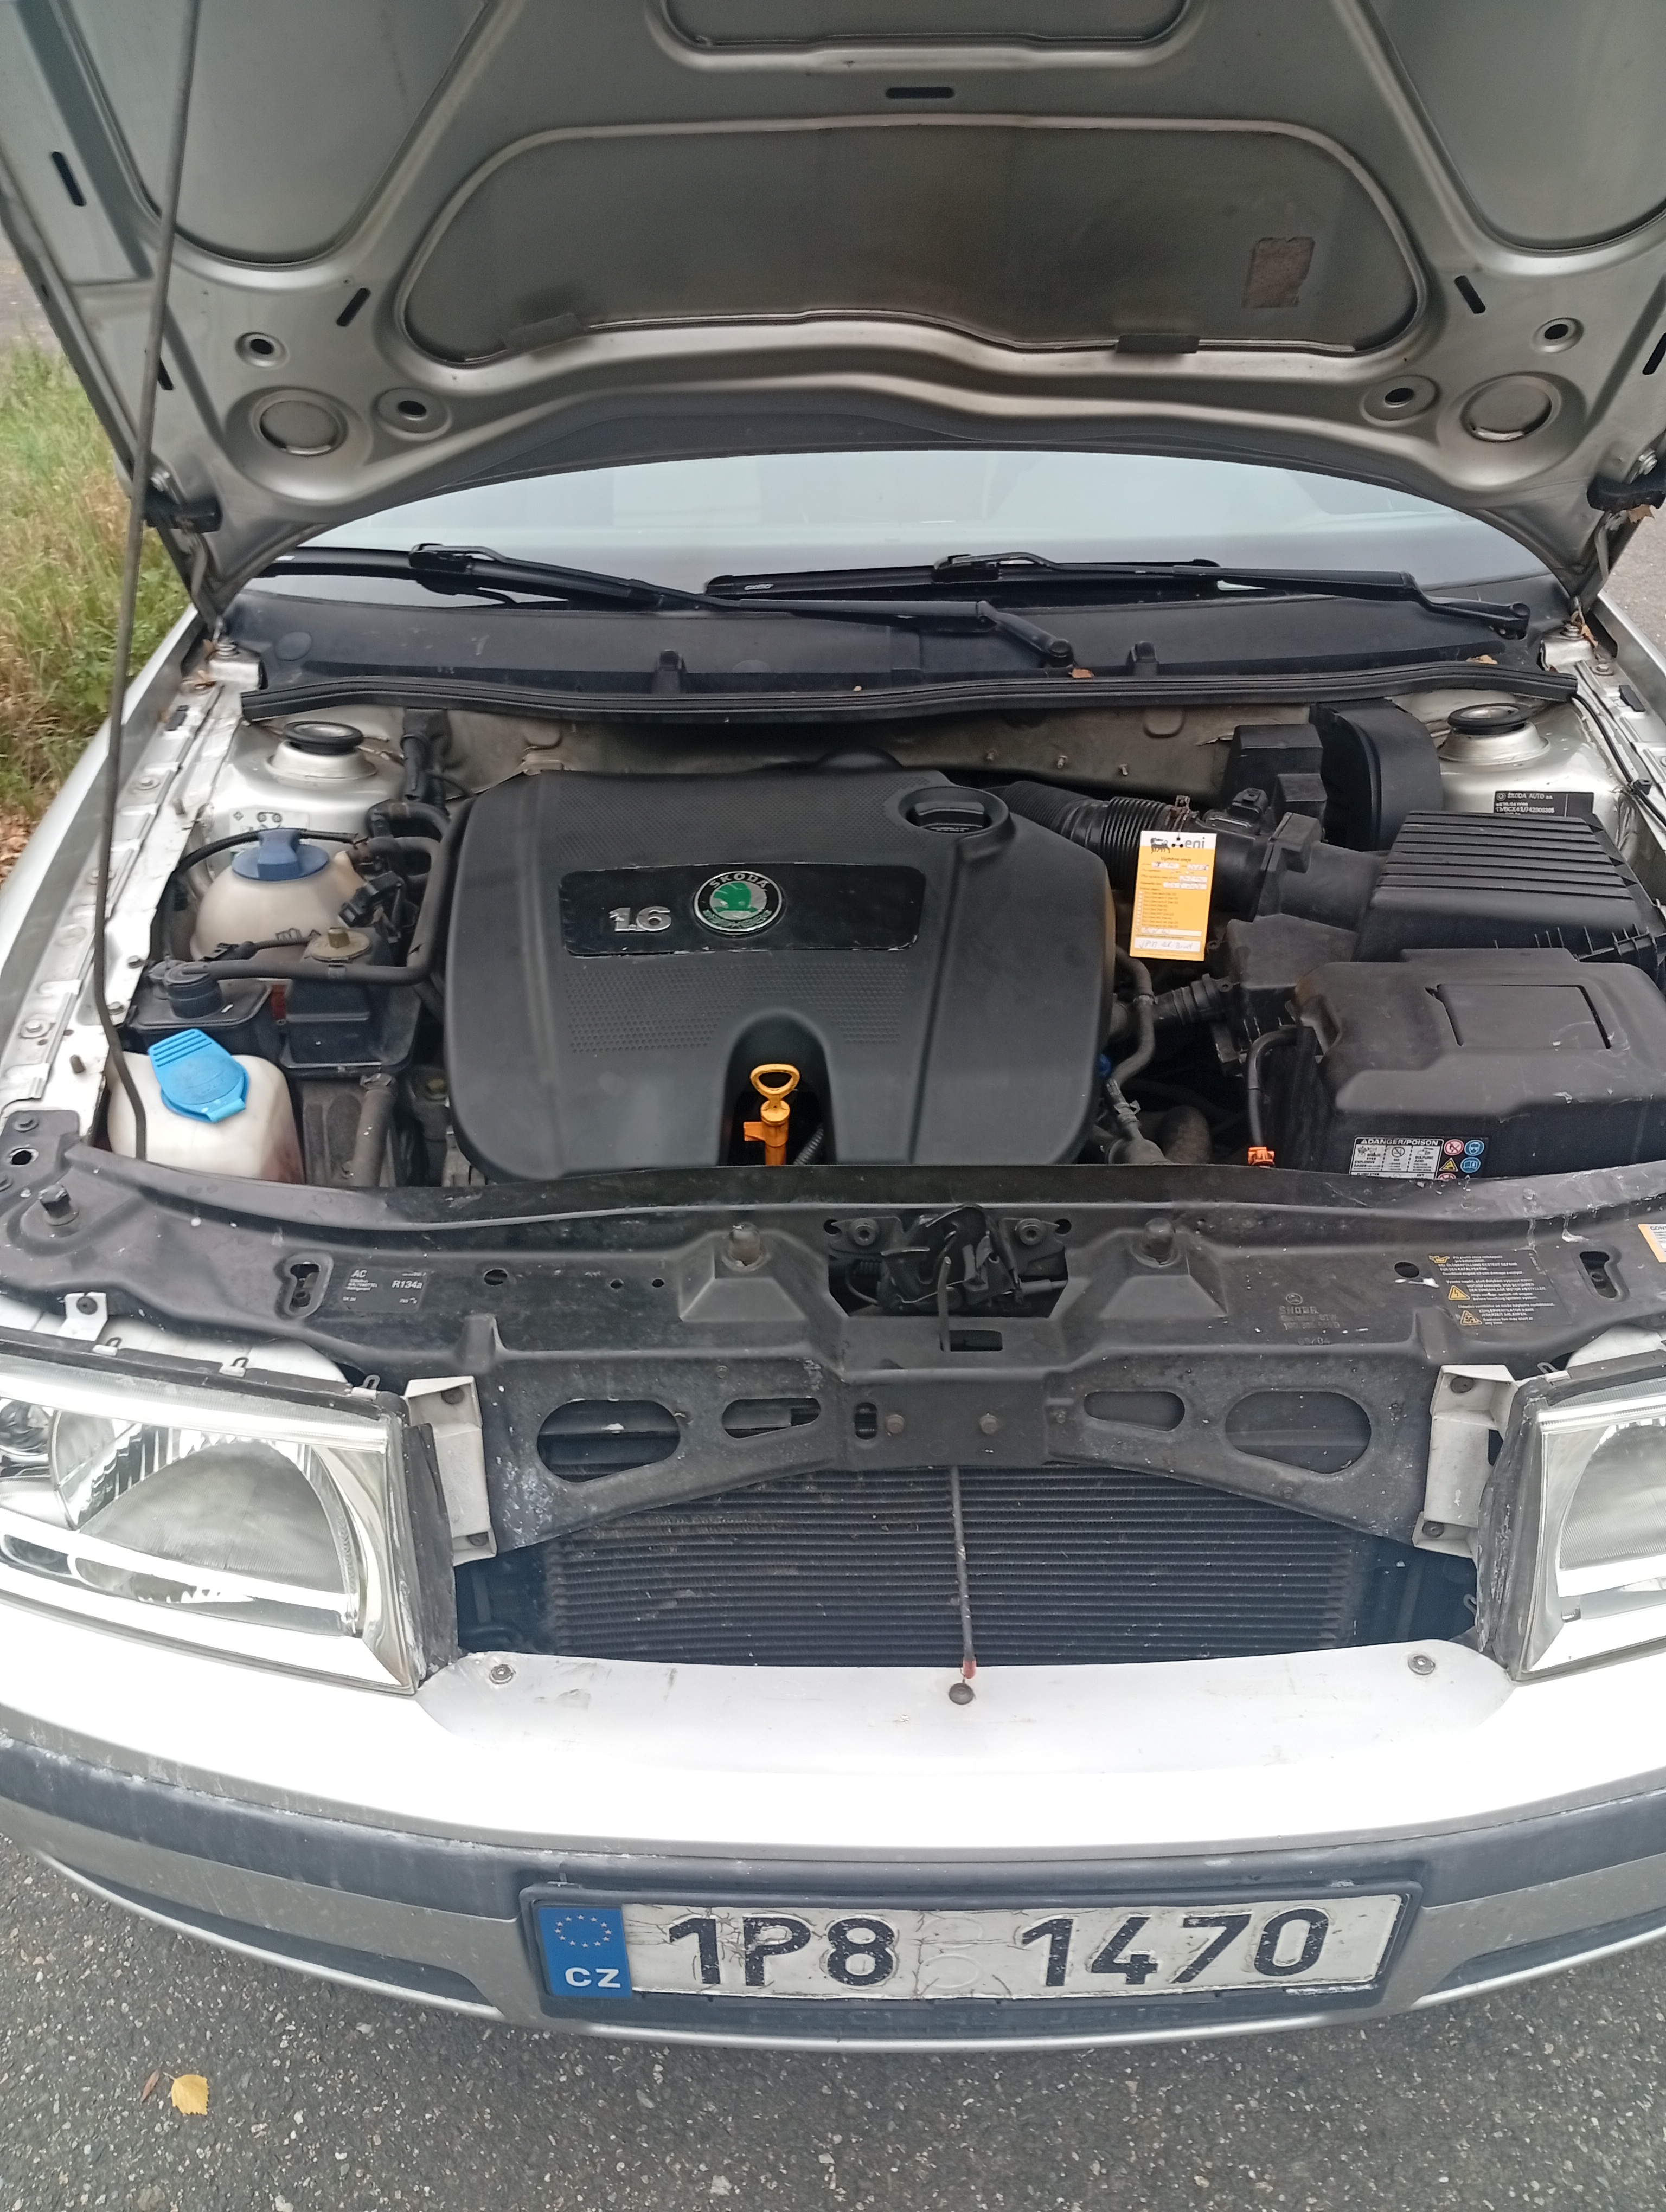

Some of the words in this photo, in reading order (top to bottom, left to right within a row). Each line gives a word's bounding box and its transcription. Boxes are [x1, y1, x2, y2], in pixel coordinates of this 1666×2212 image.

[1185, 837, 1205, 849] eni
[609, 906, 671, 931] 1.6
[351, 1269, 368, 1278] AC
[392, 1279, 423, 1289] R134a
[669, 1916, 895, 1986] 1P8
[1022, 1907, 1329, 1987] 1470
[565, 1967, 621, 1988] CZ
